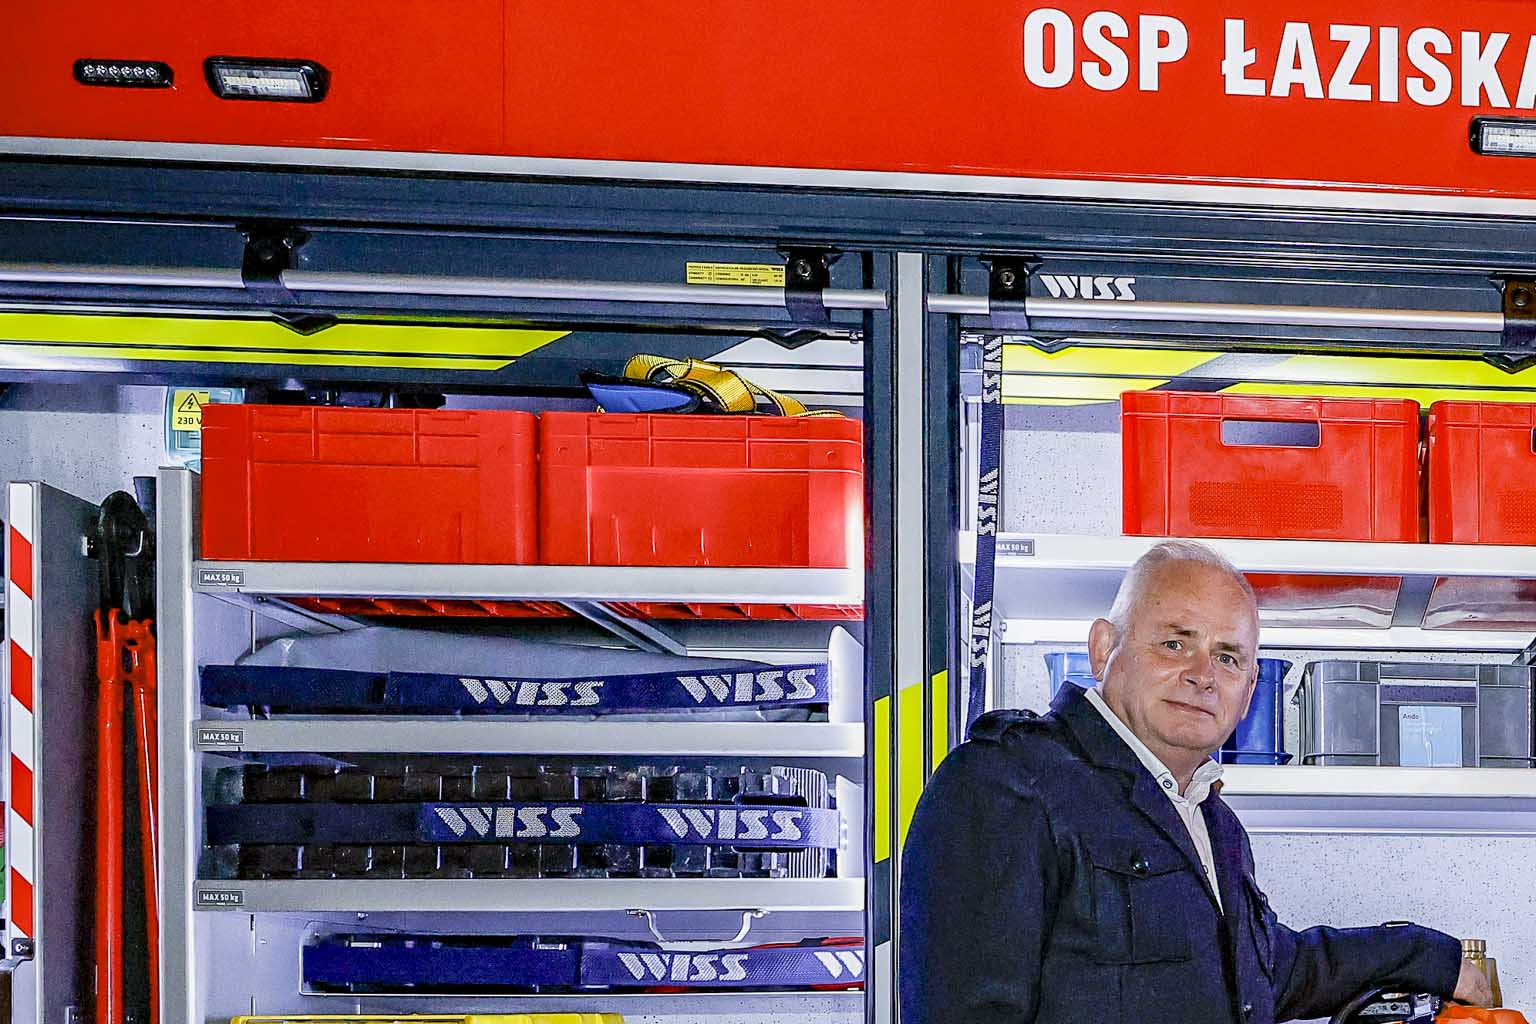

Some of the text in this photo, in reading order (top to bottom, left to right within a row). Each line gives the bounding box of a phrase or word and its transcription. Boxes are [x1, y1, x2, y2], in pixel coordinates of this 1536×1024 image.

[1023, 8, 1188, 91] OSP
[1039, 274, 1135, 301] WISS
[178, 417, 194, 425] 230
[203, 573, 220, 581] MAX
[221, 573, 231, 582] 50
[459, 678, 605, 706] WISS
[676, 668, 817, 703] WISS
[203, 732, 219, 741] MAX
[220, 733, 230, 741] 50
[433, 806, 583, 838] WISS
[657, 808, 803, 840] WISS
[202, 893, 239, 903] MAX 50 kg
[617, 952, 749, 982] WISS
